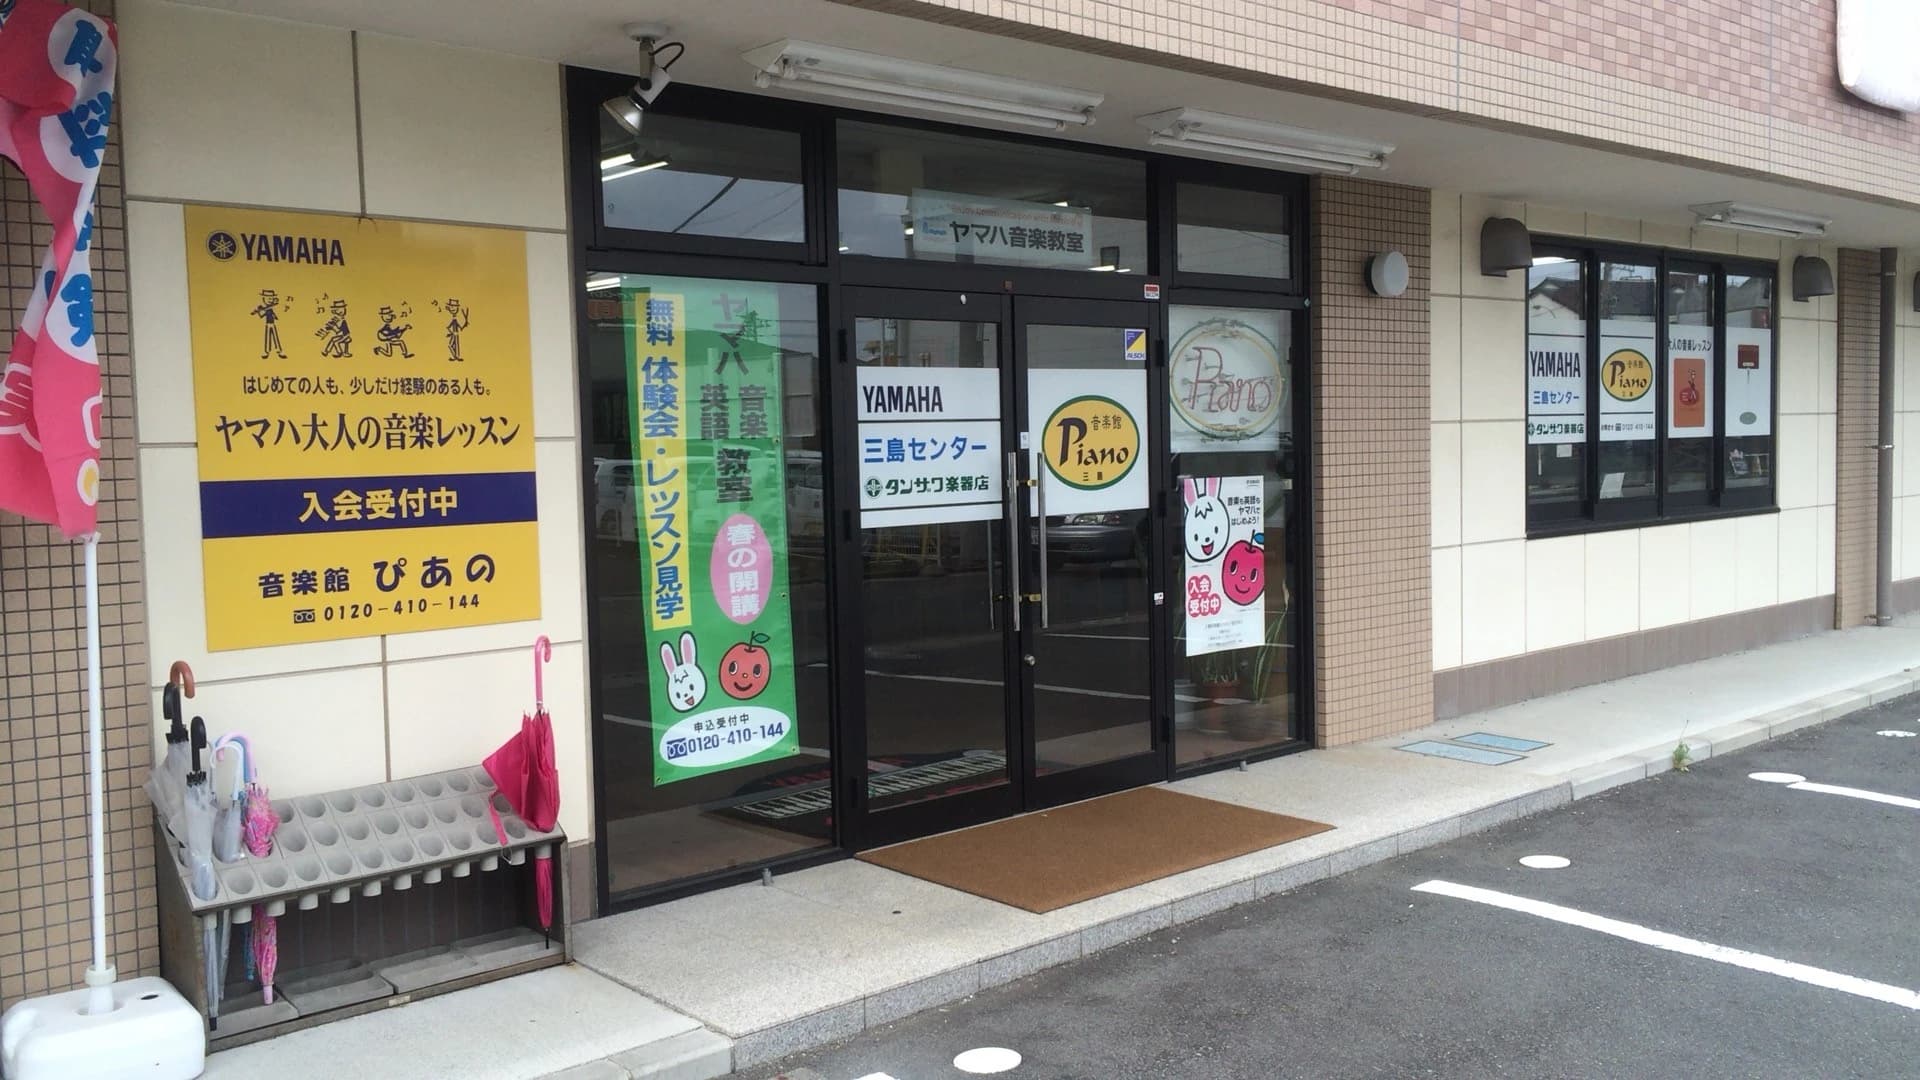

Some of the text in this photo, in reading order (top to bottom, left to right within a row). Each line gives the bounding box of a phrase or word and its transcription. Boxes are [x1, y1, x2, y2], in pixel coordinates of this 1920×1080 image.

[240, 233, 345, 266] YAMAHA
[950, 220, 1084, 253] ヤマハ音楽教室
[712, 293, 749, 375] ヤマハ
[1530, 351, 1581, 378] YAMAHA
[1610, 360, 1648, 388] Piano
[242, 375, 491, 397] はじめての人も、少しだけ経験のある人も。
[863, 385, 943, 413] YAMAHA
[1533, 391, 1580, 404] 三島センター
[701, 384, 729, 440] 英語
[739, 384, 768, 440] 音楽
[1090, 414, 1122, 431] 音楽館
[214, 412, 520, 453] ヤマハ大人の音楽レッスン
[1057, 417, 1129, 466] Piano
[641, 298, 684, 620] 無料 体験会・レッスン見学
[864, 436, 987, 463] 三島センター
[716, 448, 752, 503] 教室
[885, 475, 989, 496] タンサワ楽器店
[299, 486, 458, 523] 入会受付中
[258, 553, 495, 599] 音楽館 ぴあの
[726, 523, 760, 618] 春の開講
[1189, 578, 1210, 594] 入会
[324, 593, 480, 621] 0120-410-144
[1189, 596, 1220, 614] 受付中
[687, 721, 783, 754] 0120-410-144
[693, 713, 750, 733] 申込受付中
